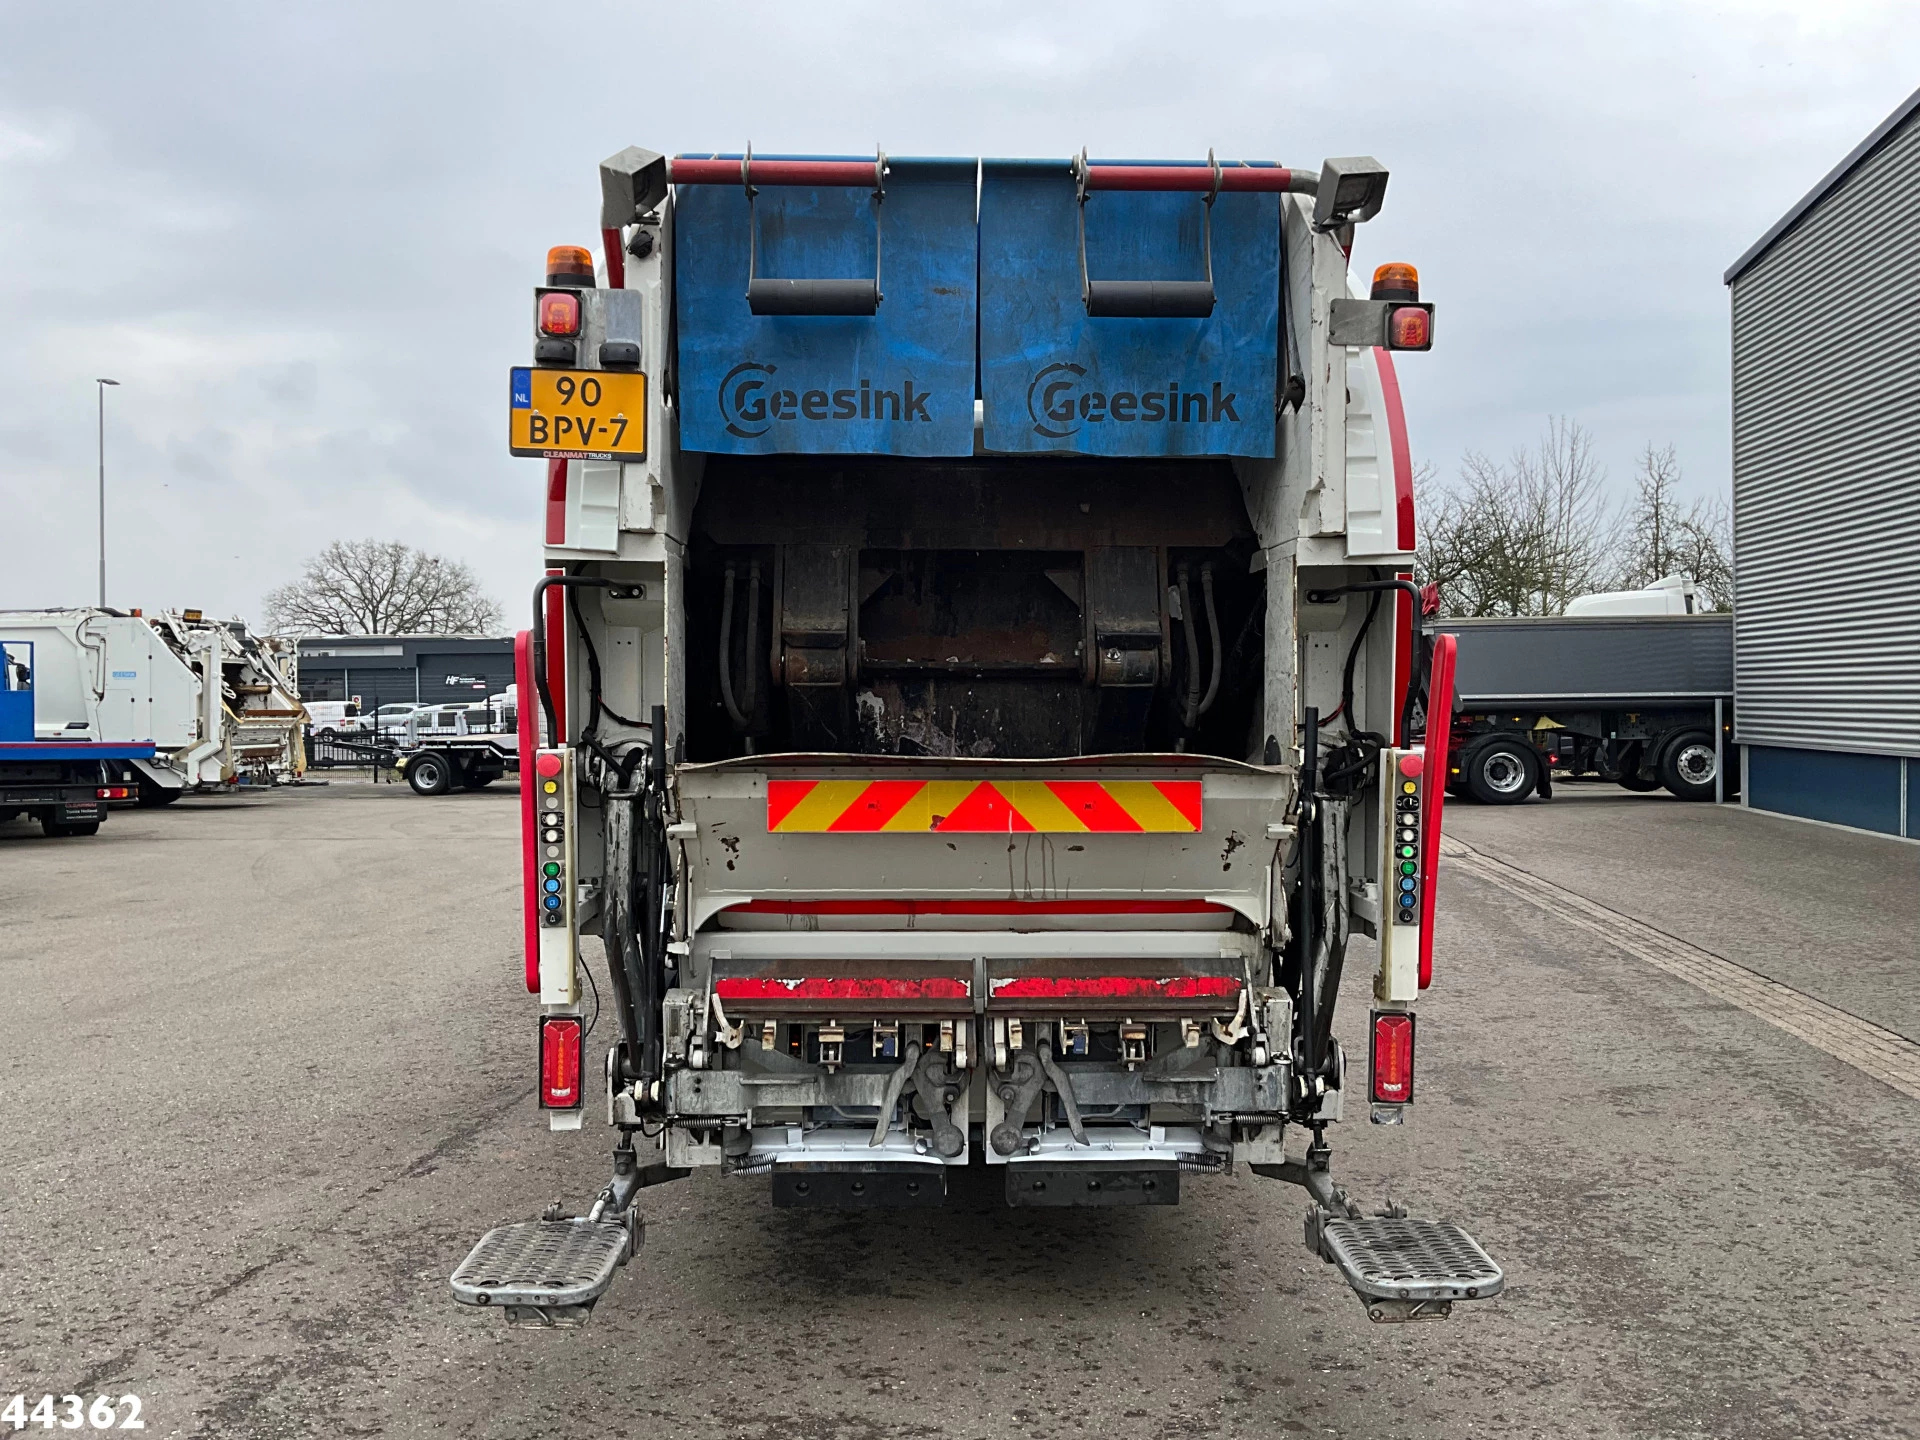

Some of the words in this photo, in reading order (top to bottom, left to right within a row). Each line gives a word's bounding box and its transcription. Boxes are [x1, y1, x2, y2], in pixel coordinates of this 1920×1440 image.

[515, 393, 529, 403] NL
[556, 376, 602, 407] 90
[734, 379, 932, 422] Geesink
[1043, 382, 1240, 423] Geesink
[529, 415, 629, 447] BPV-7
